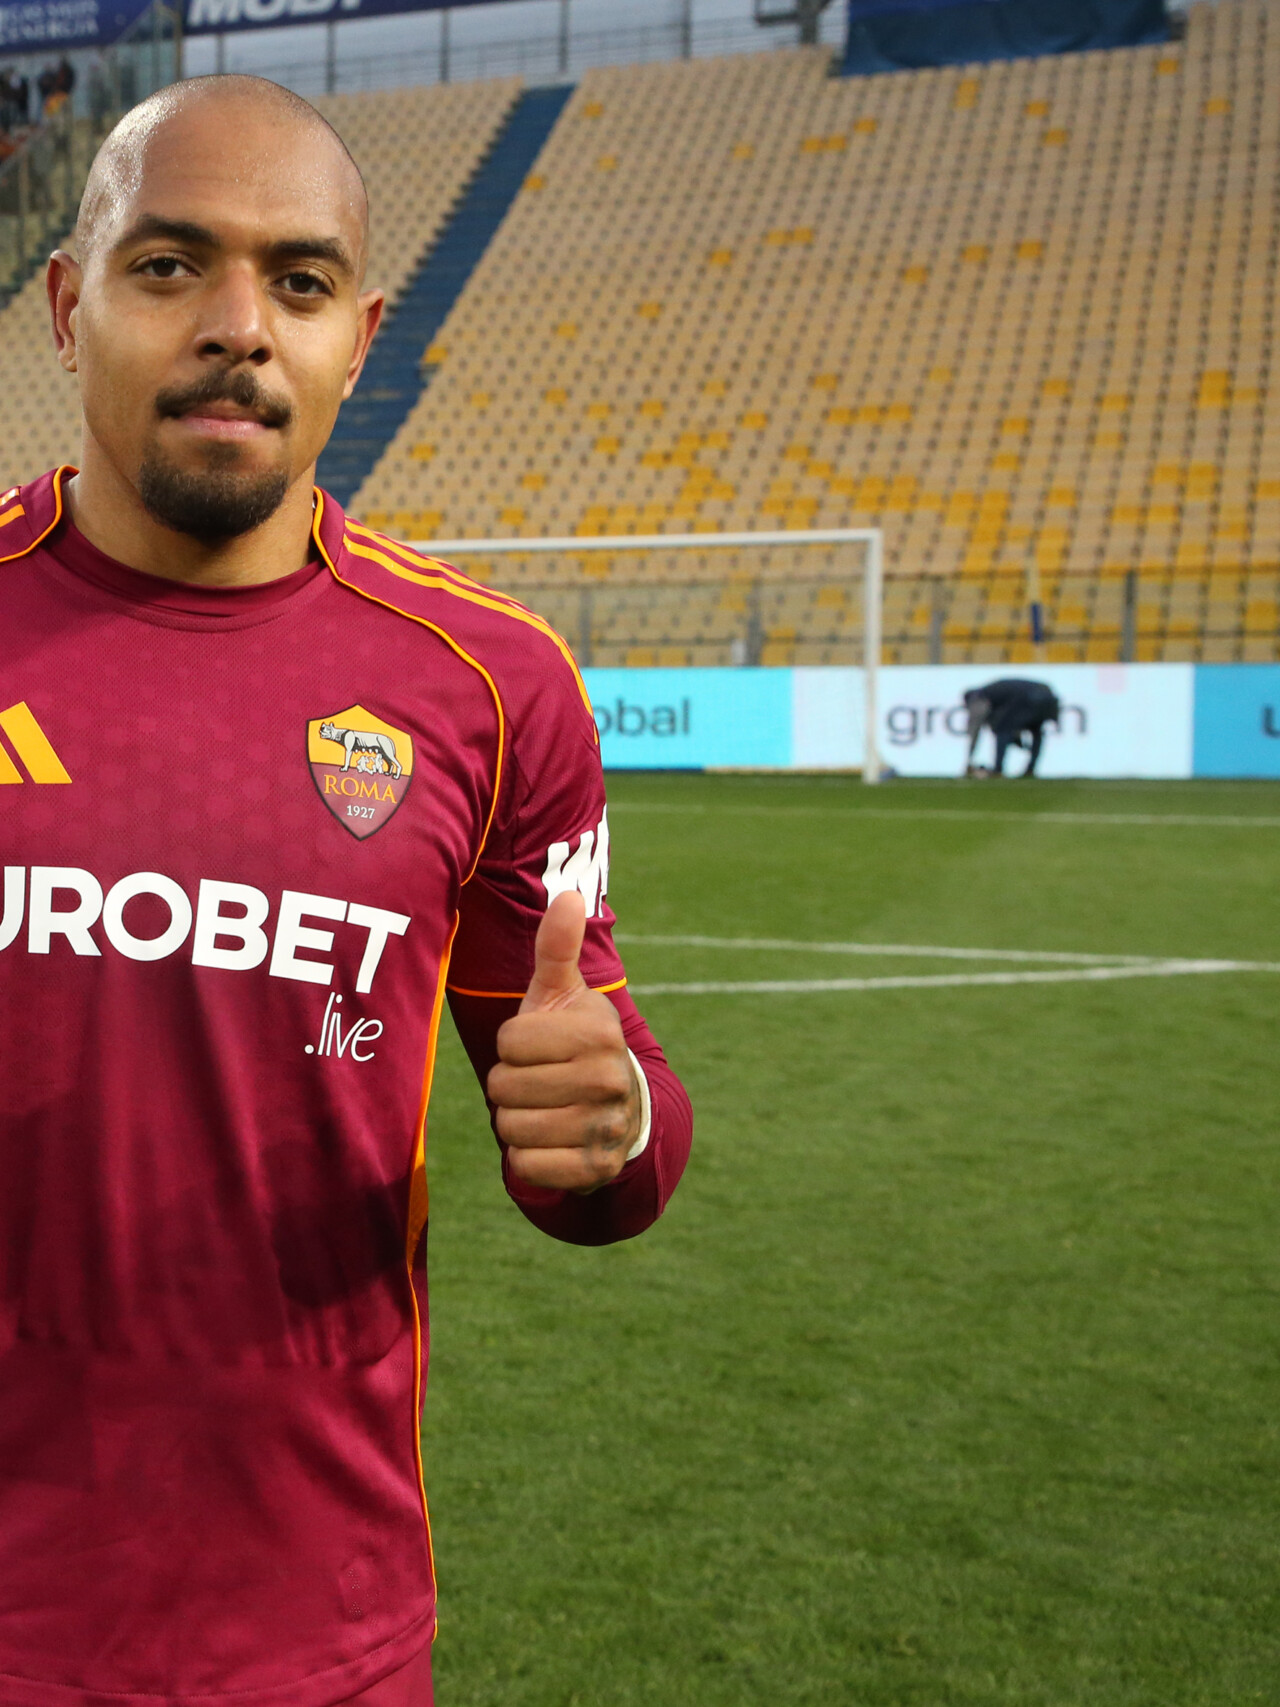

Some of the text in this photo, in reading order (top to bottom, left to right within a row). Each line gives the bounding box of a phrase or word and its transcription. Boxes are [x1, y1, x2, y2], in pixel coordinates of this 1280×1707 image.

[593, 695, 690, 738] obal
[323, 774, 398, 805] ROMA
[346, 804, 376, 820] 1927
